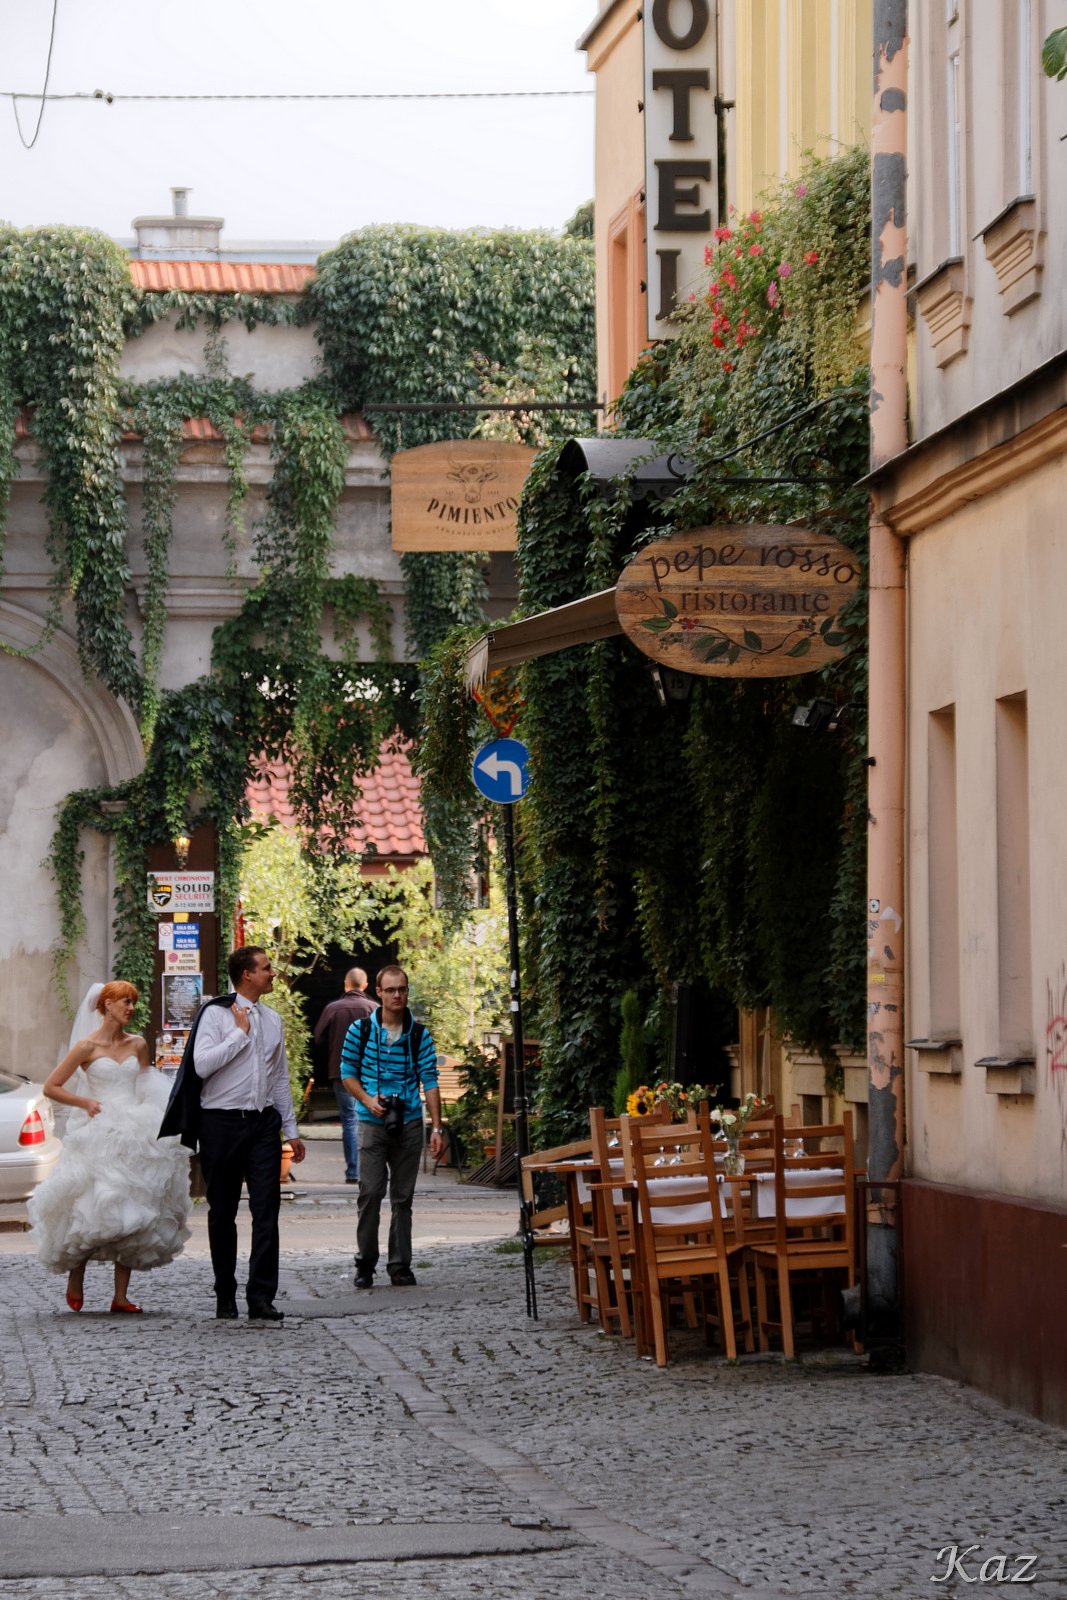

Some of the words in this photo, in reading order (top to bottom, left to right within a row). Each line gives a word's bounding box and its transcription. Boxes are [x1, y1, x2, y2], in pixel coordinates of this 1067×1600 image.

[427, 497, 518, 524] PIMIENTO
[645, 544, 744, 592] pepe
[760, 544, 861, 584] rosso
[680, 587, 830, 613] ristorante
[175, 884, 211, 893] SOLID
